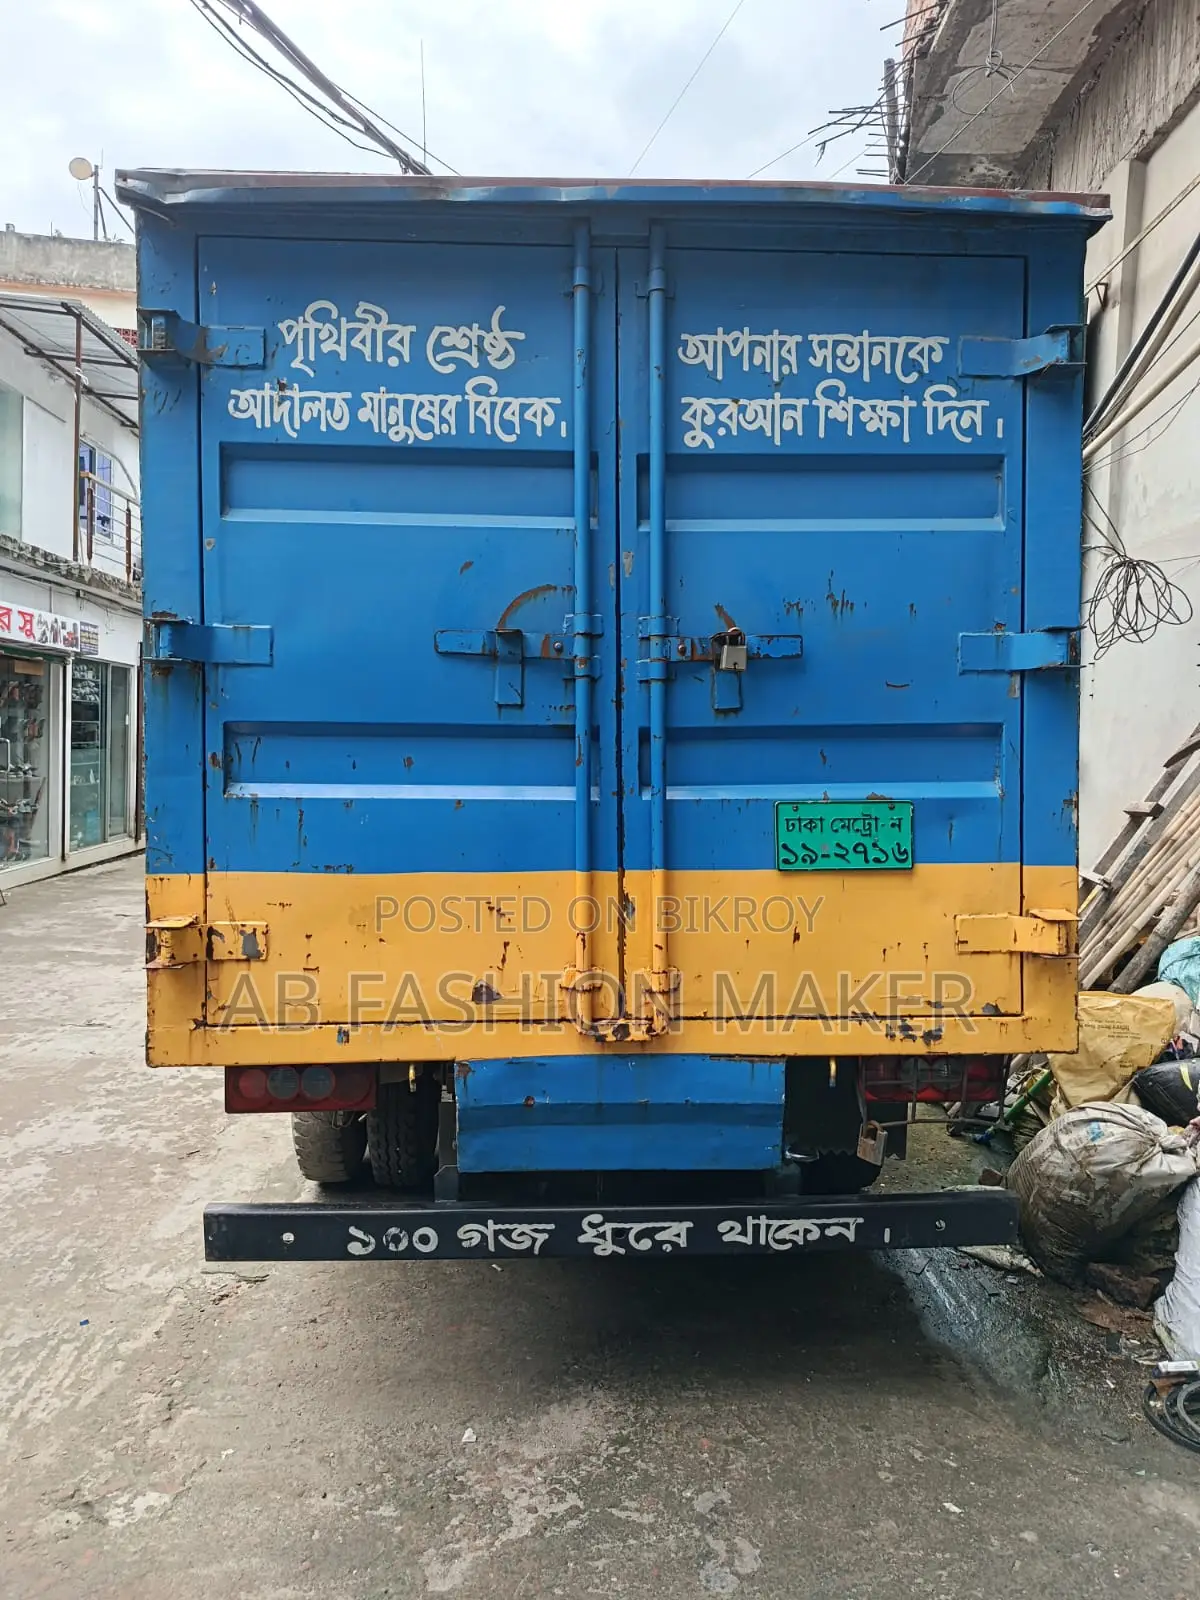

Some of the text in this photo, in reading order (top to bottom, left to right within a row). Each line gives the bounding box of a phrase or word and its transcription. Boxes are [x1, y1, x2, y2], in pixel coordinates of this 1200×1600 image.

[277, 300, 526, 377] পৃথিবীর শ্রেষ্ঠ
[677, 327, 951, 384] আপনার সন্তানকে
[227, 382, 352, 438] আদালত
[357, 386, 462, 445] মানুষের
[681, 392, 810, 449] কুরআন
[812, 378, 918, 443] শিক্ষা
[781, 841, 909, 865] ১৯-২৭১৬
[785, 816, 825, 833] ঢাকা
[347, 1225, 439, 1256] ১০০
[456, 1219, 556, 1255] গজ
